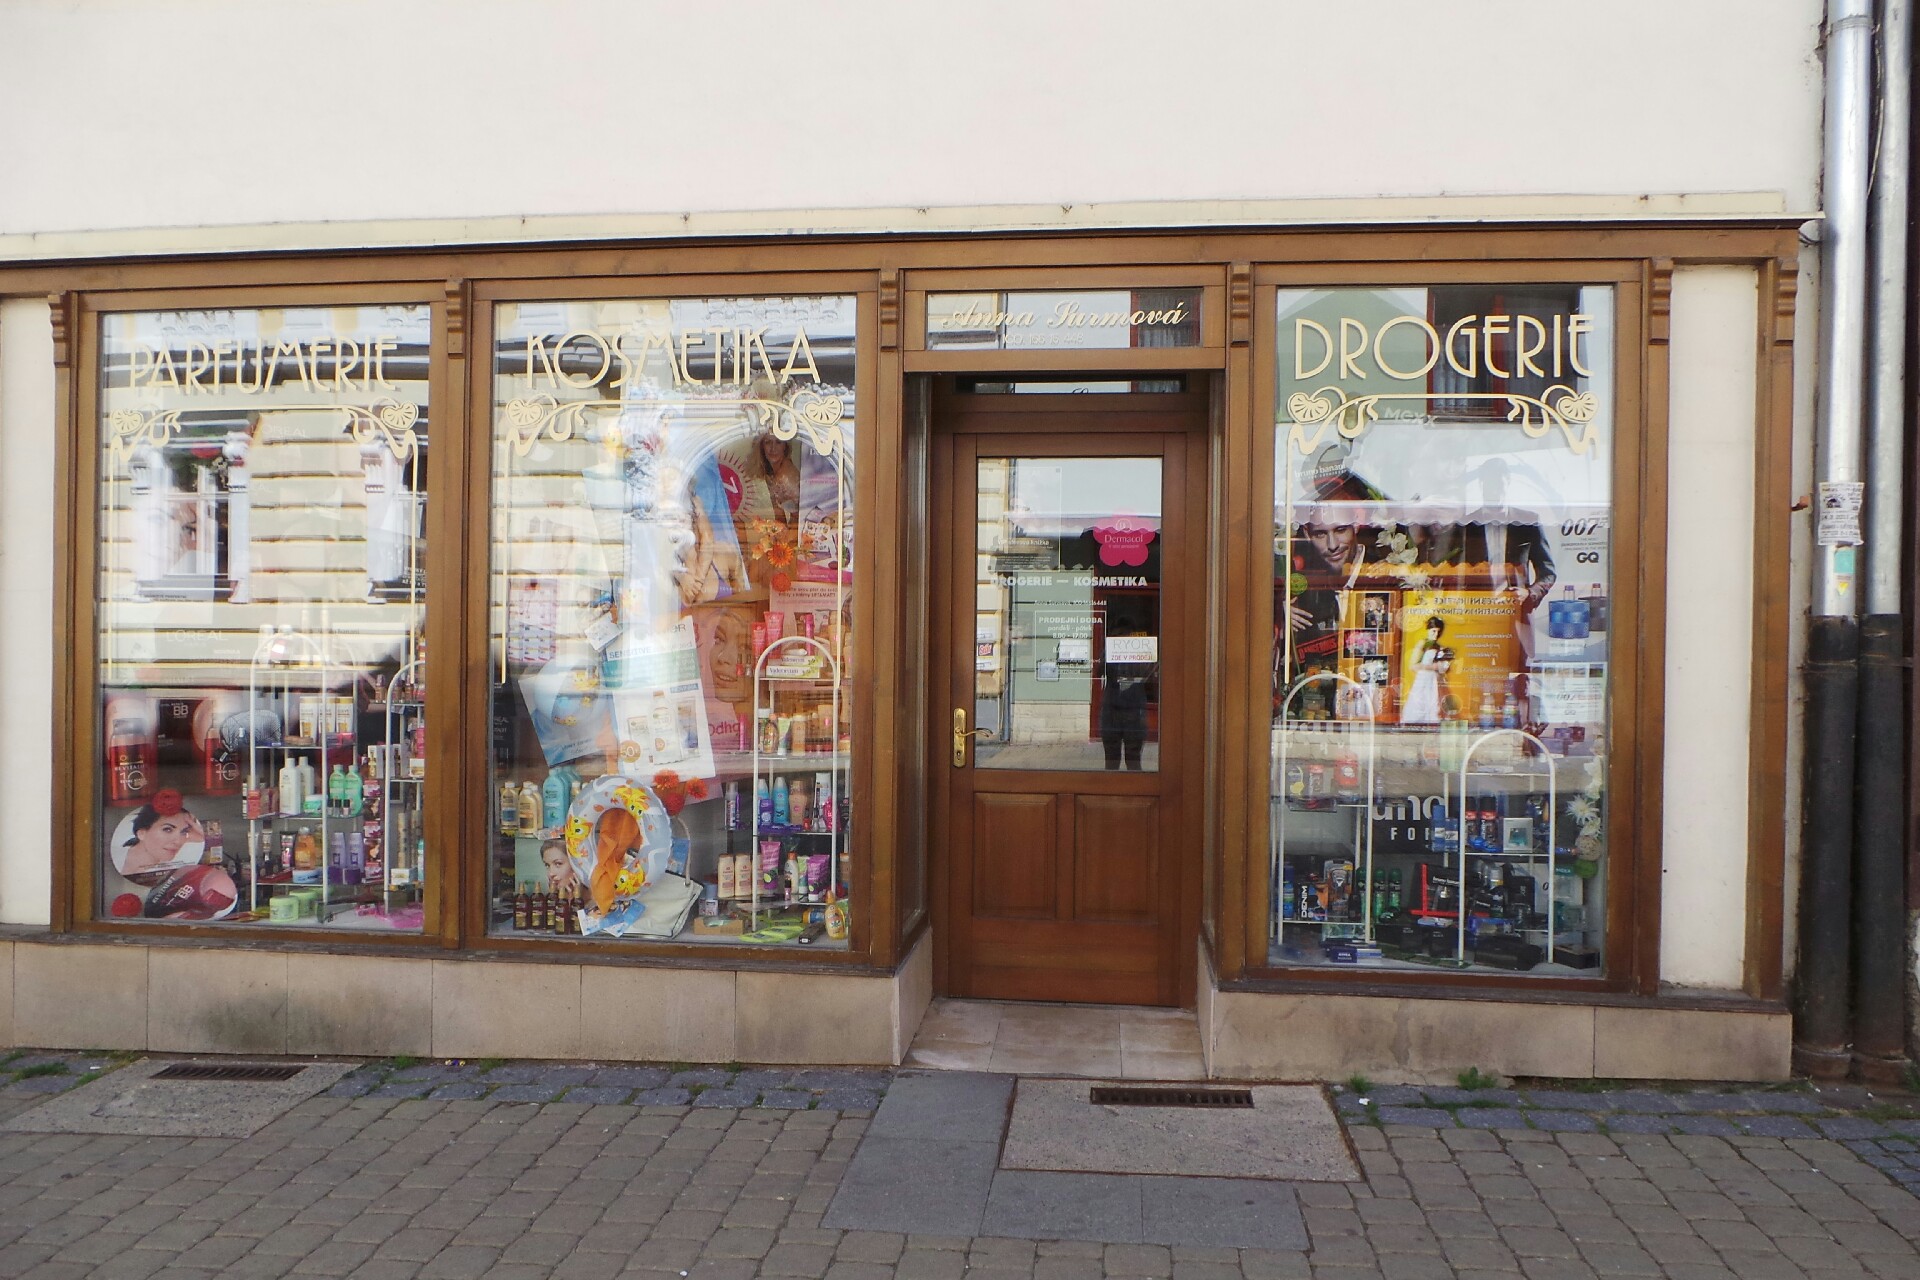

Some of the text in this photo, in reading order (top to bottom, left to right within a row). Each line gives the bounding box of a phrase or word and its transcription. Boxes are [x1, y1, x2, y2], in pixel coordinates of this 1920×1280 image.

[942, 299, 1039, 328] Anna
[1294, 314, 1595, 380] DROGERIE
[526, 326, 821, 389] KOSMETIKA
[129, 335, 401, 395] PARFUMERIE
[1294, 469, 1318, 478] bruno
[1561, 518, 1601, 537] 007
[1104, 534, 1144, 543] Dermacol
[1576, 551, 1599, 563] GQ
[1073, 575, 1148, 587] KOSMETIKA
[1038, 615, 1103, 624] PRODEJNÍ DOBA
[1113, 638, 1151, 650] RYOR
